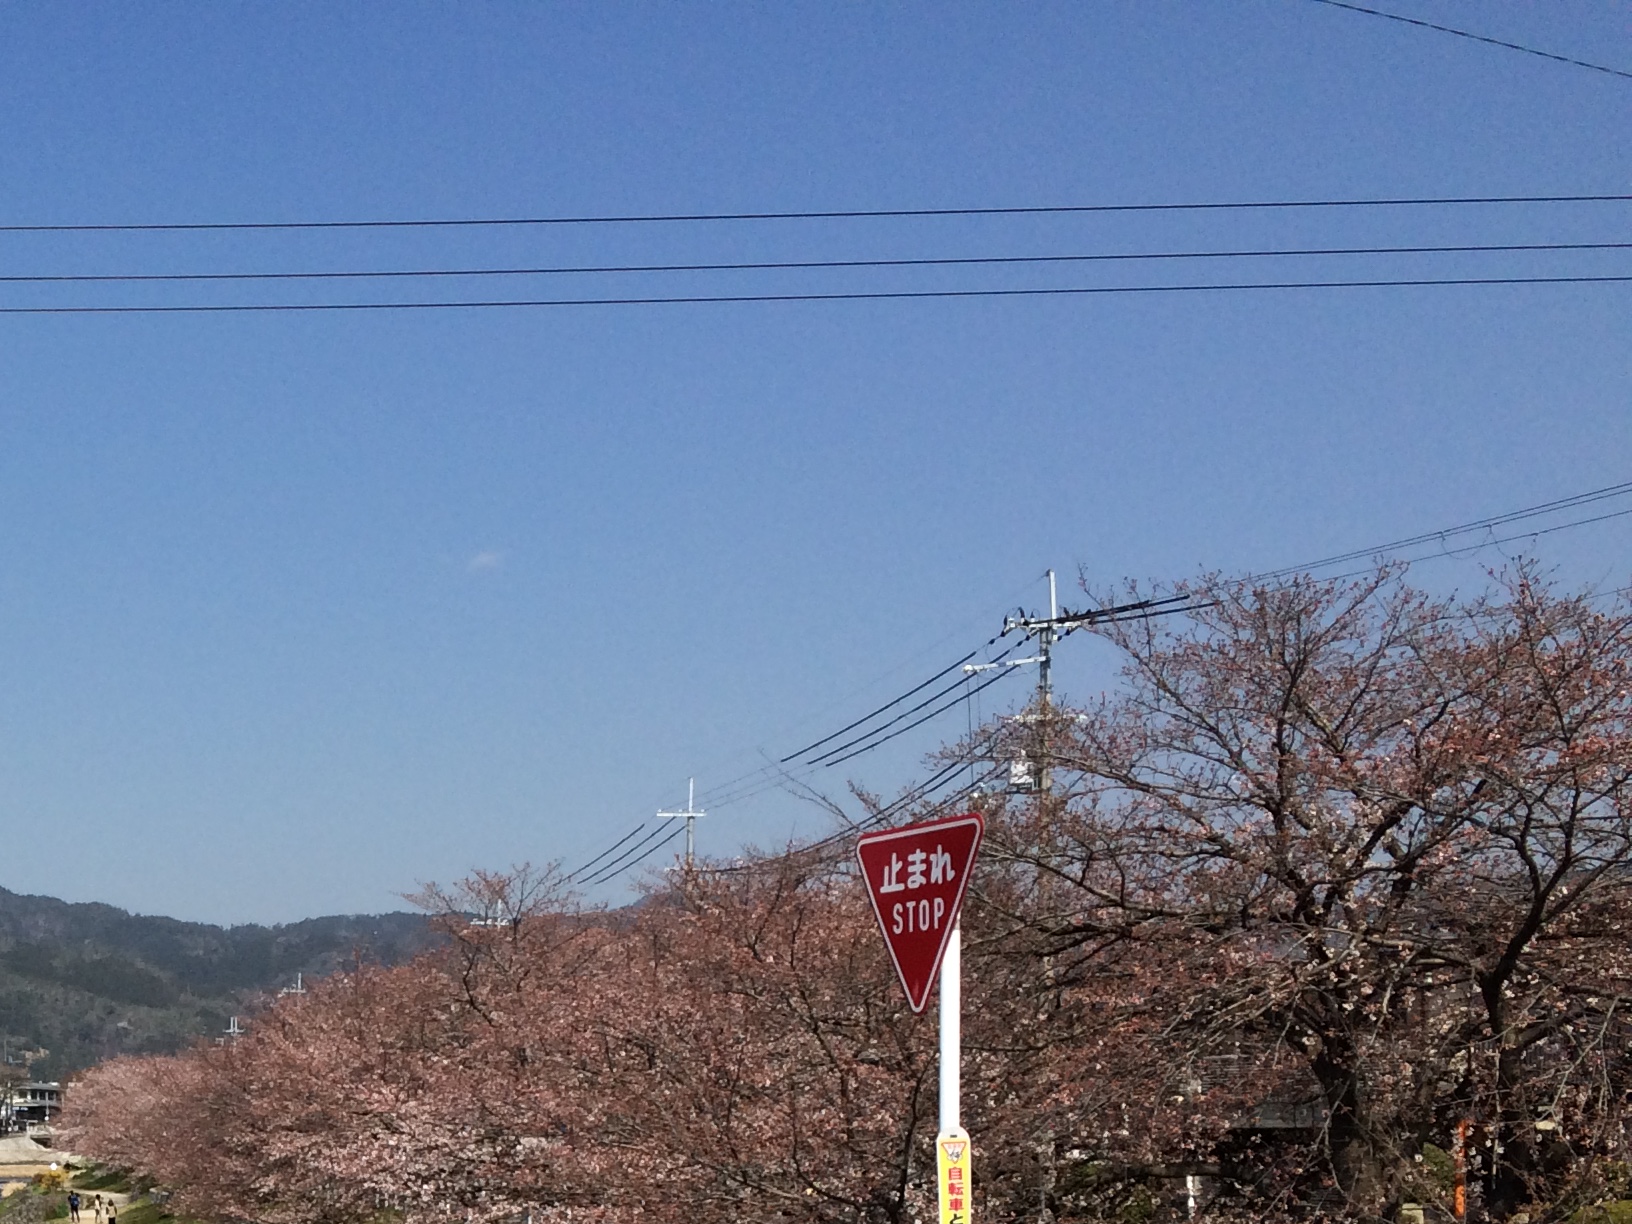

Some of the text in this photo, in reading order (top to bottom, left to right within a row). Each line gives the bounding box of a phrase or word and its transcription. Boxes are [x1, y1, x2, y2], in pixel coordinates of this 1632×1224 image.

[880, 844, 956, 893] 止まれ
[892, 897, 945, 935] STOP
